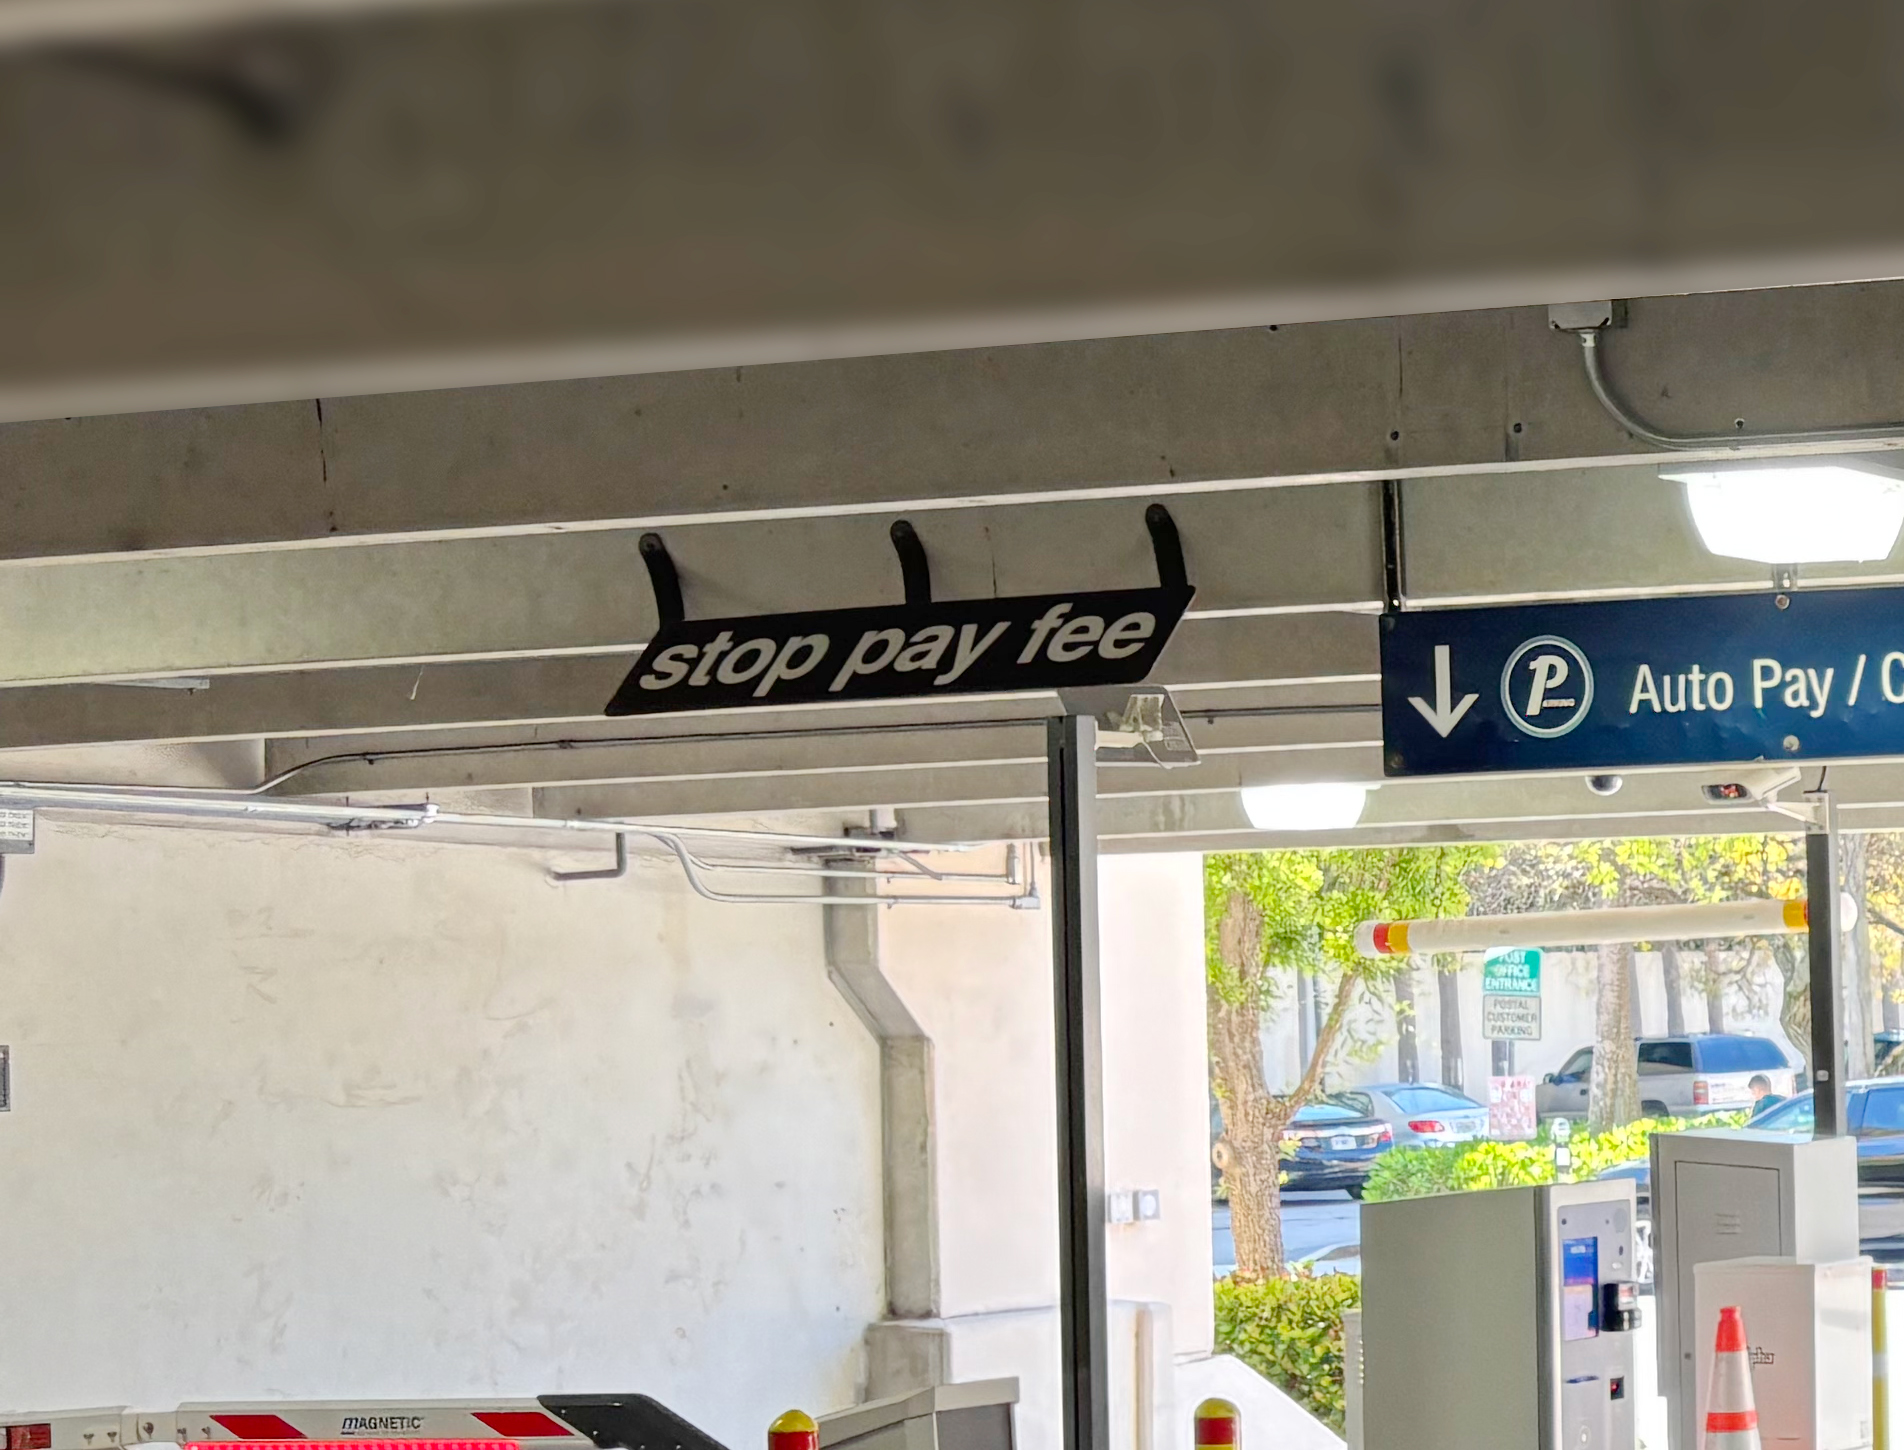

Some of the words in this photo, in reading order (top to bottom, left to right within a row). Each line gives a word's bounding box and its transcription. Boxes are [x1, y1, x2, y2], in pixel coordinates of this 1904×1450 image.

[639, 629, 829, 697] stop
[829, 622, 1012, 691] pay
[1016, 602, 1156, 663] fee
[1628, 663, 1734, 714] Auto
[1752, 658, 1835, 719] Pay
[1847, 653, 1867, 707] /
